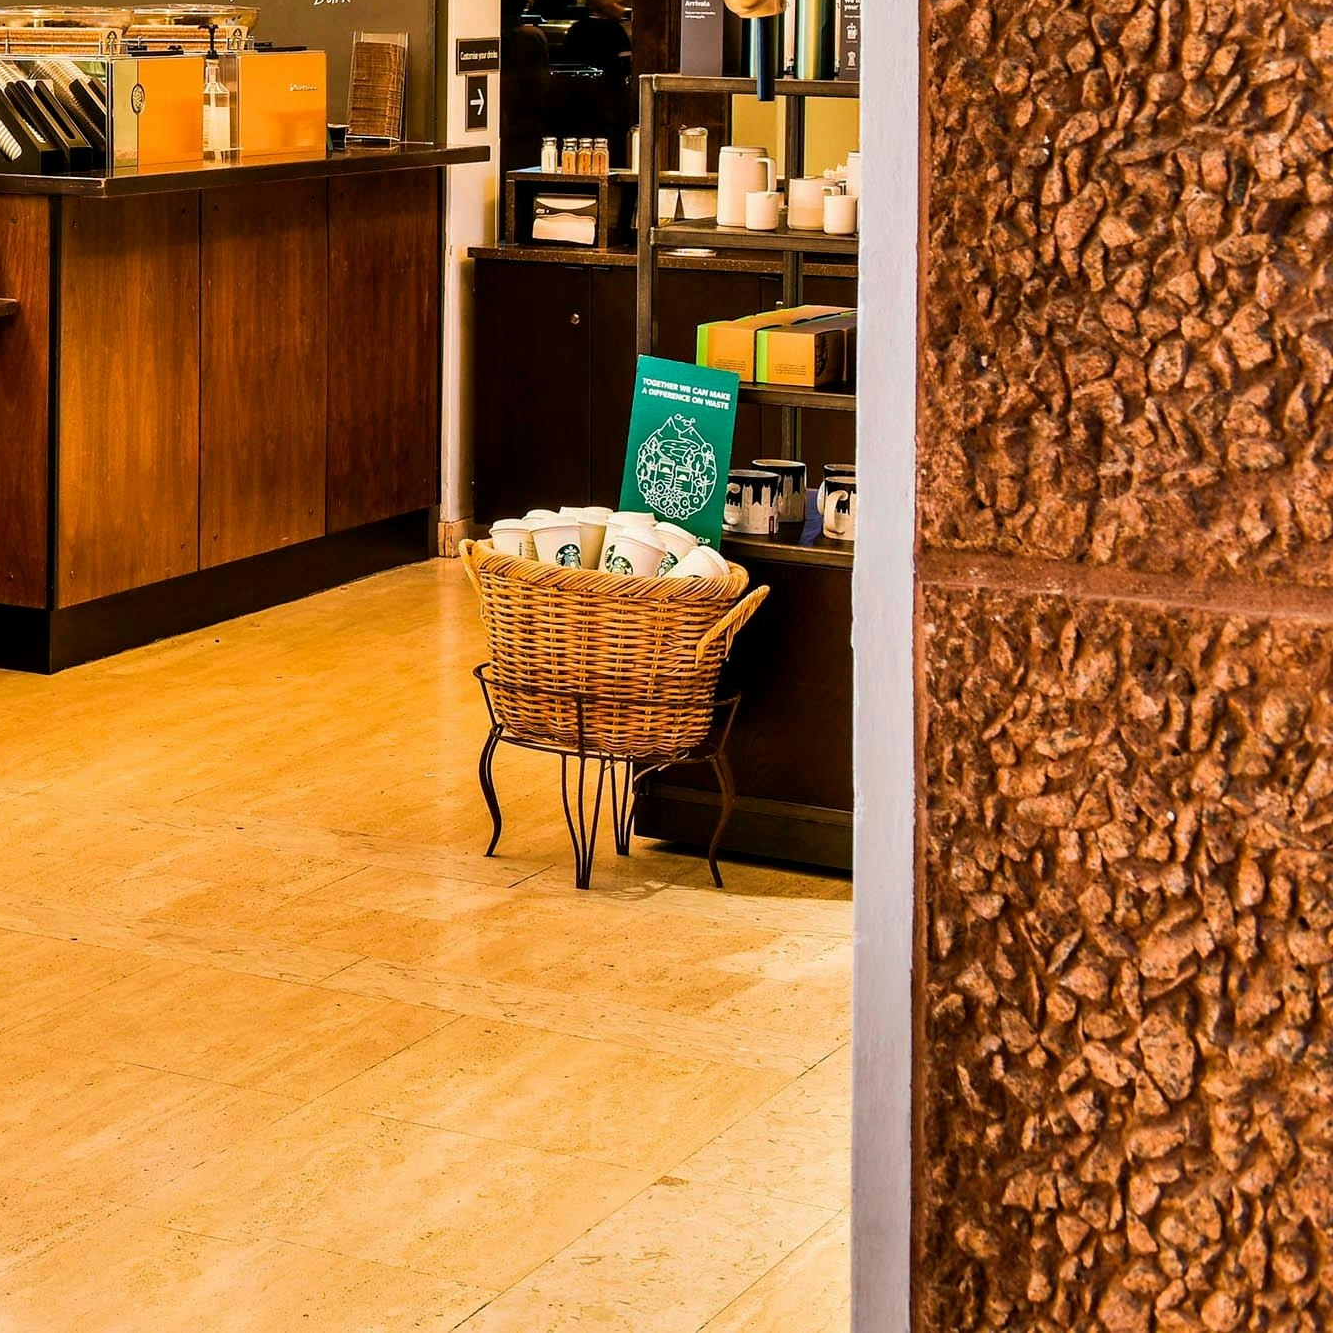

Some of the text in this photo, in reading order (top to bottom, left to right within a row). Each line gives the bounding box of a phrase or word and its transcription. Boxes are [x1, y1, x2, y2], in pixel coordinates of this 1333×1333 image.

[642, 378, 731, 401] TOGETHER WE CAN MAKE
[648, 388, 690, 403] DIFFERENCE
[691, 396, 704, 405] ON
[704, 398, 730, 410] WASTE
[697, 537, 711, 545] CUP
